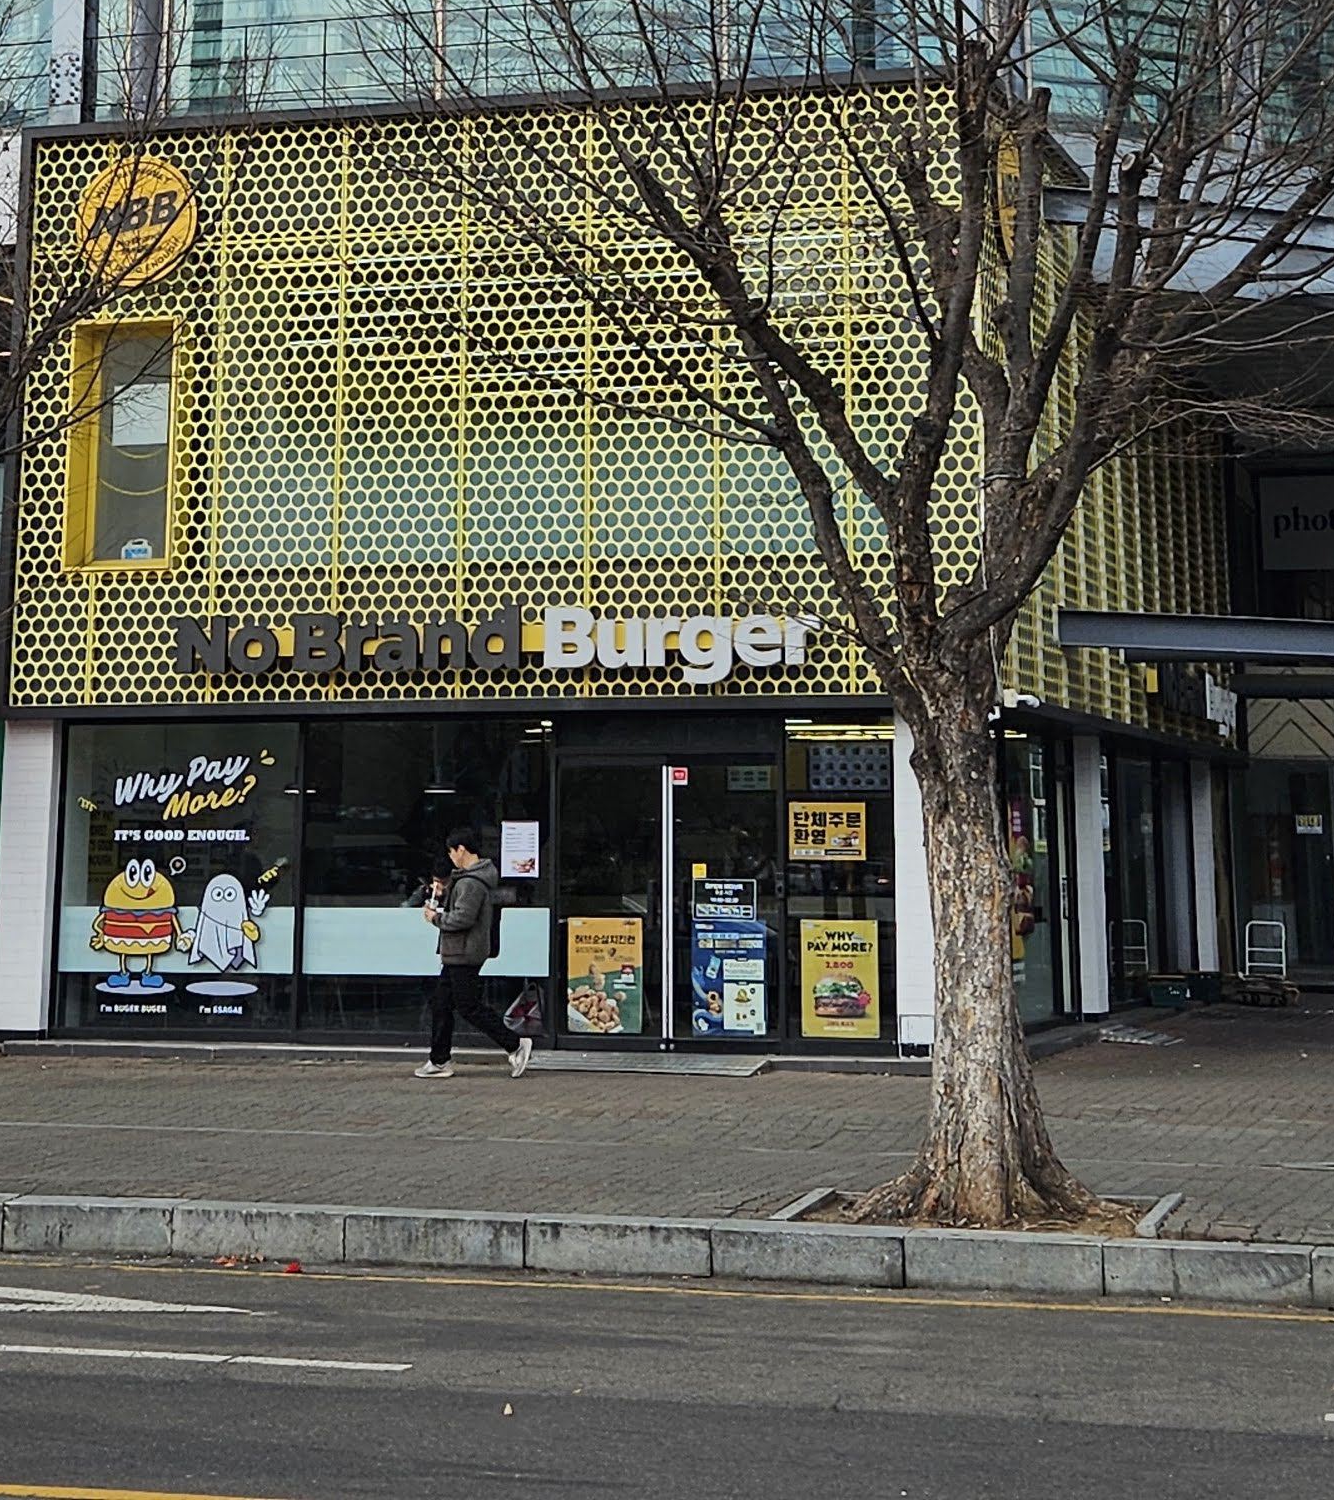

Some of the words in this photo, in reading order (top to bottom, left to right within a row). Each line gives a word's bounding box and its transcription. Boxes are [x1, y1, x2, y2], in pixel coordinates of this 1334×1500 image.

[90, 190, 178, 238] NBB
[175, 615, 273, 674] No
[291, 603, 521, 673] Brand
[544, 606, 819, 684] Burger
[113, 767, 184, 806] Why
[186, 753, 251, 789] Pay
[163, 776, 257, 820] More?
[793, 811, 861, 828] 단체주문
[114, 829, 141, 841] IT'S
[143, 829, 185, 841] GOOD
[187, 829, 250, 841] ENOUGH.
[794, 829, 826, 845] 환영
[825, 931, 855, 942] WHY
[807, 942, 828, 952] PAY
[831, 942, 873, 953] MORE?
